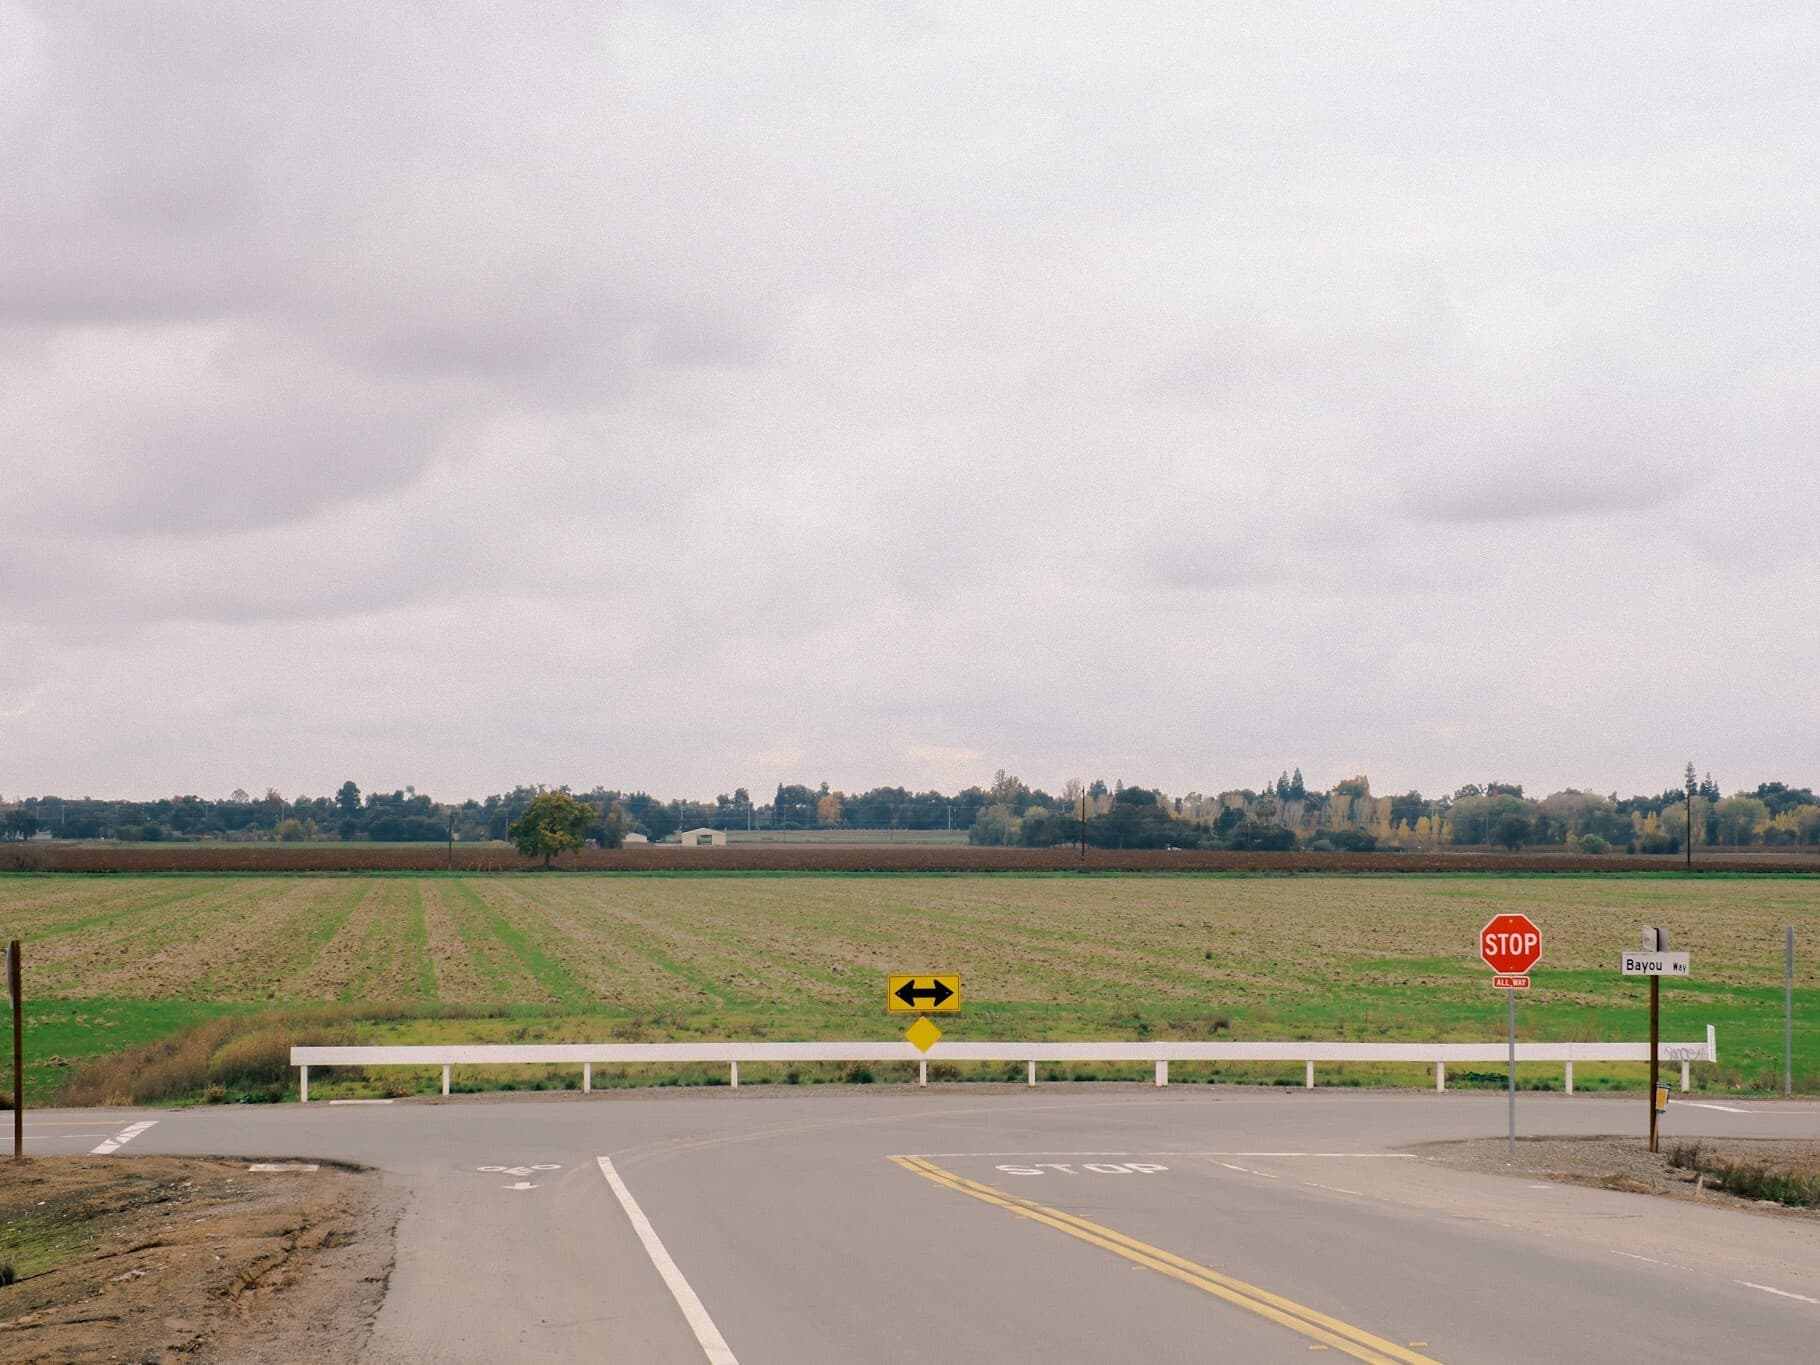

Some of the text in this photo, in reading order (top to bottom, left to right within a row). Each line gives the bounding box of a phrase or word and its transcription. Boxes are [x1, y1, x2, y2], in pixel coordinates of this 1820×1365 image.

[1485, 933, 1537, 956] STOP
[1626, 959, 1687, 974] Bayou Way
[1496, 978, 1527, 986] ALL WAY
[995, 1163, 1169, 1175] STOP
